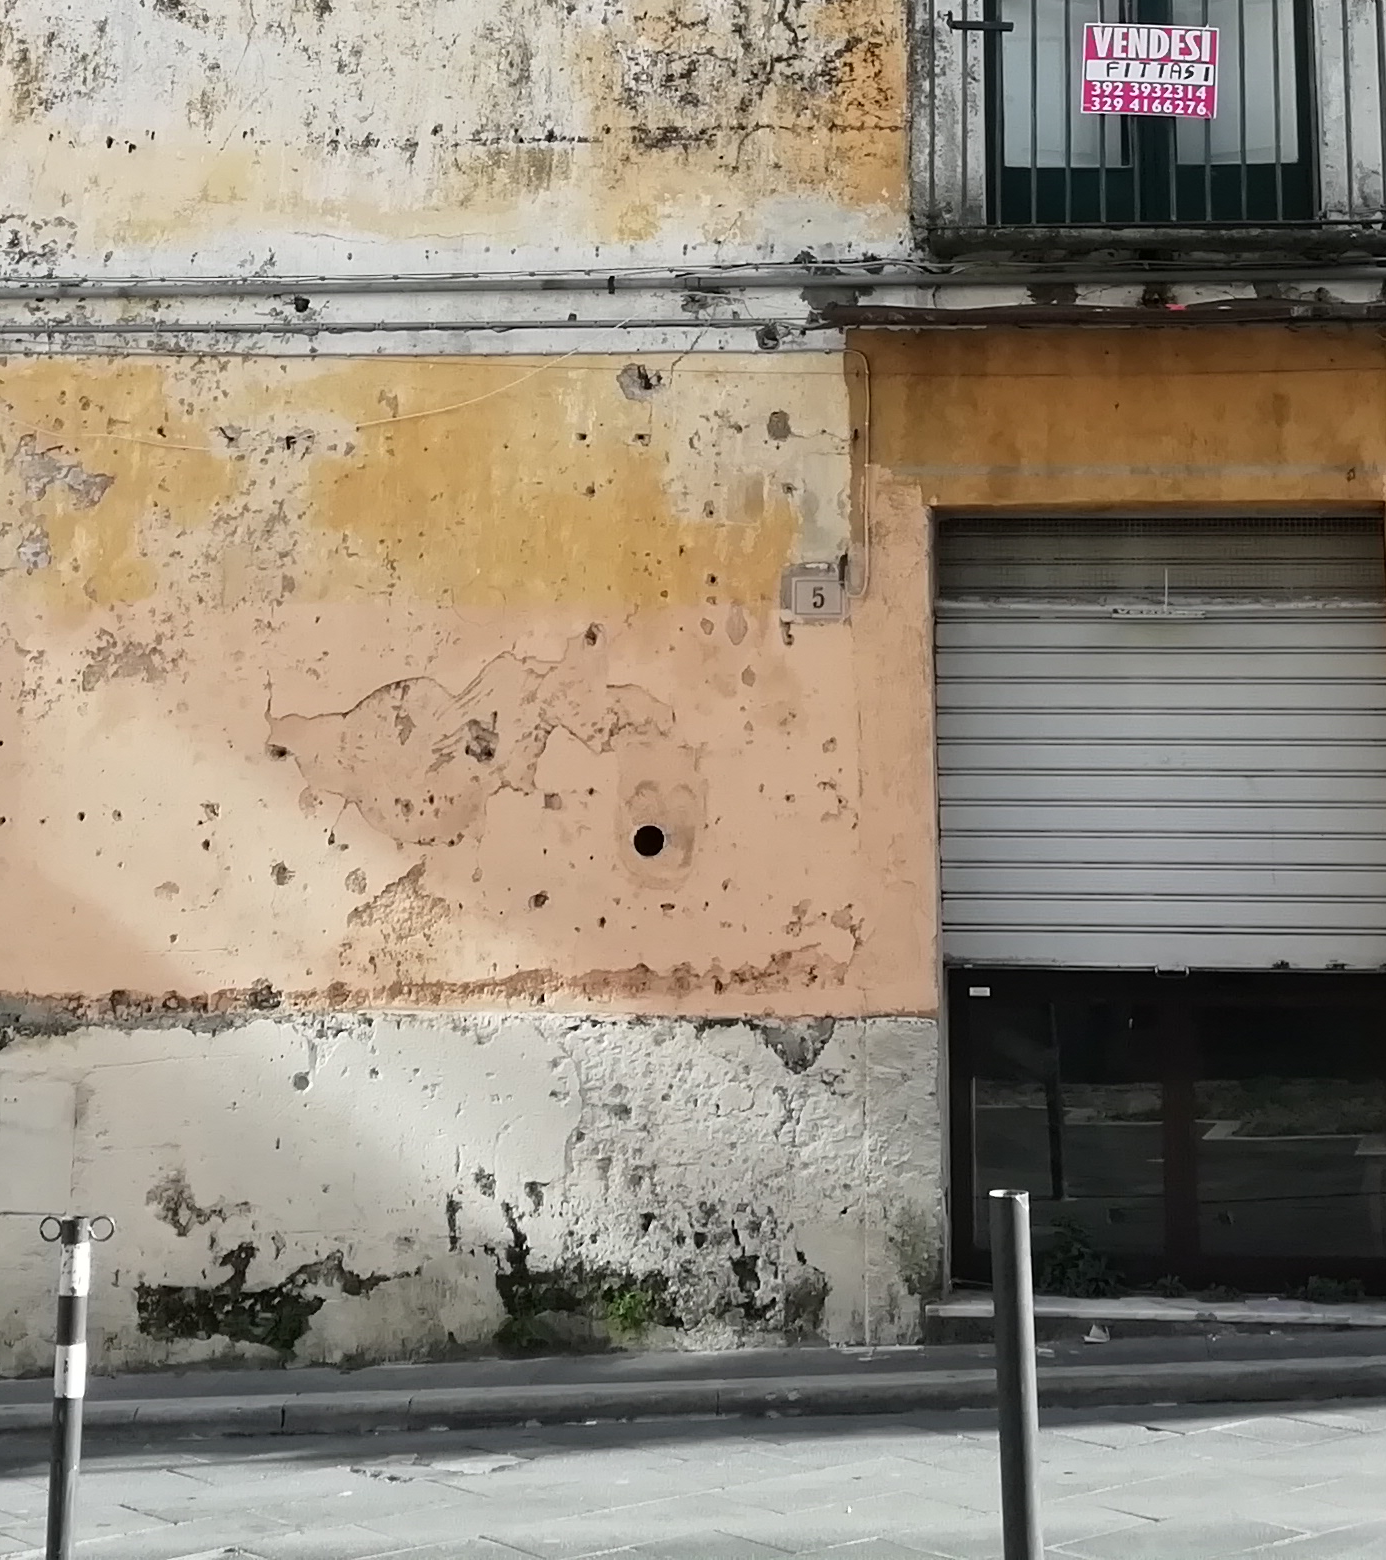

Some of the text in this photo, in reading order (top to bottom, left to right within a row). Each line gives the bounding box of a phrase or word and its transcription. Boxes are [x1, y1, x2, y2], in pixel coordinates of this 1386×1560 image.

[1092, 26, 1211, 62] VENDESI
[1106, 61, 1211, 82] FITTASI
[1091, 81, 1207, 100] 392 3932314
[1091, 96, 1207, 115] 329 4166276
[812, 586, 826, 609] 5
